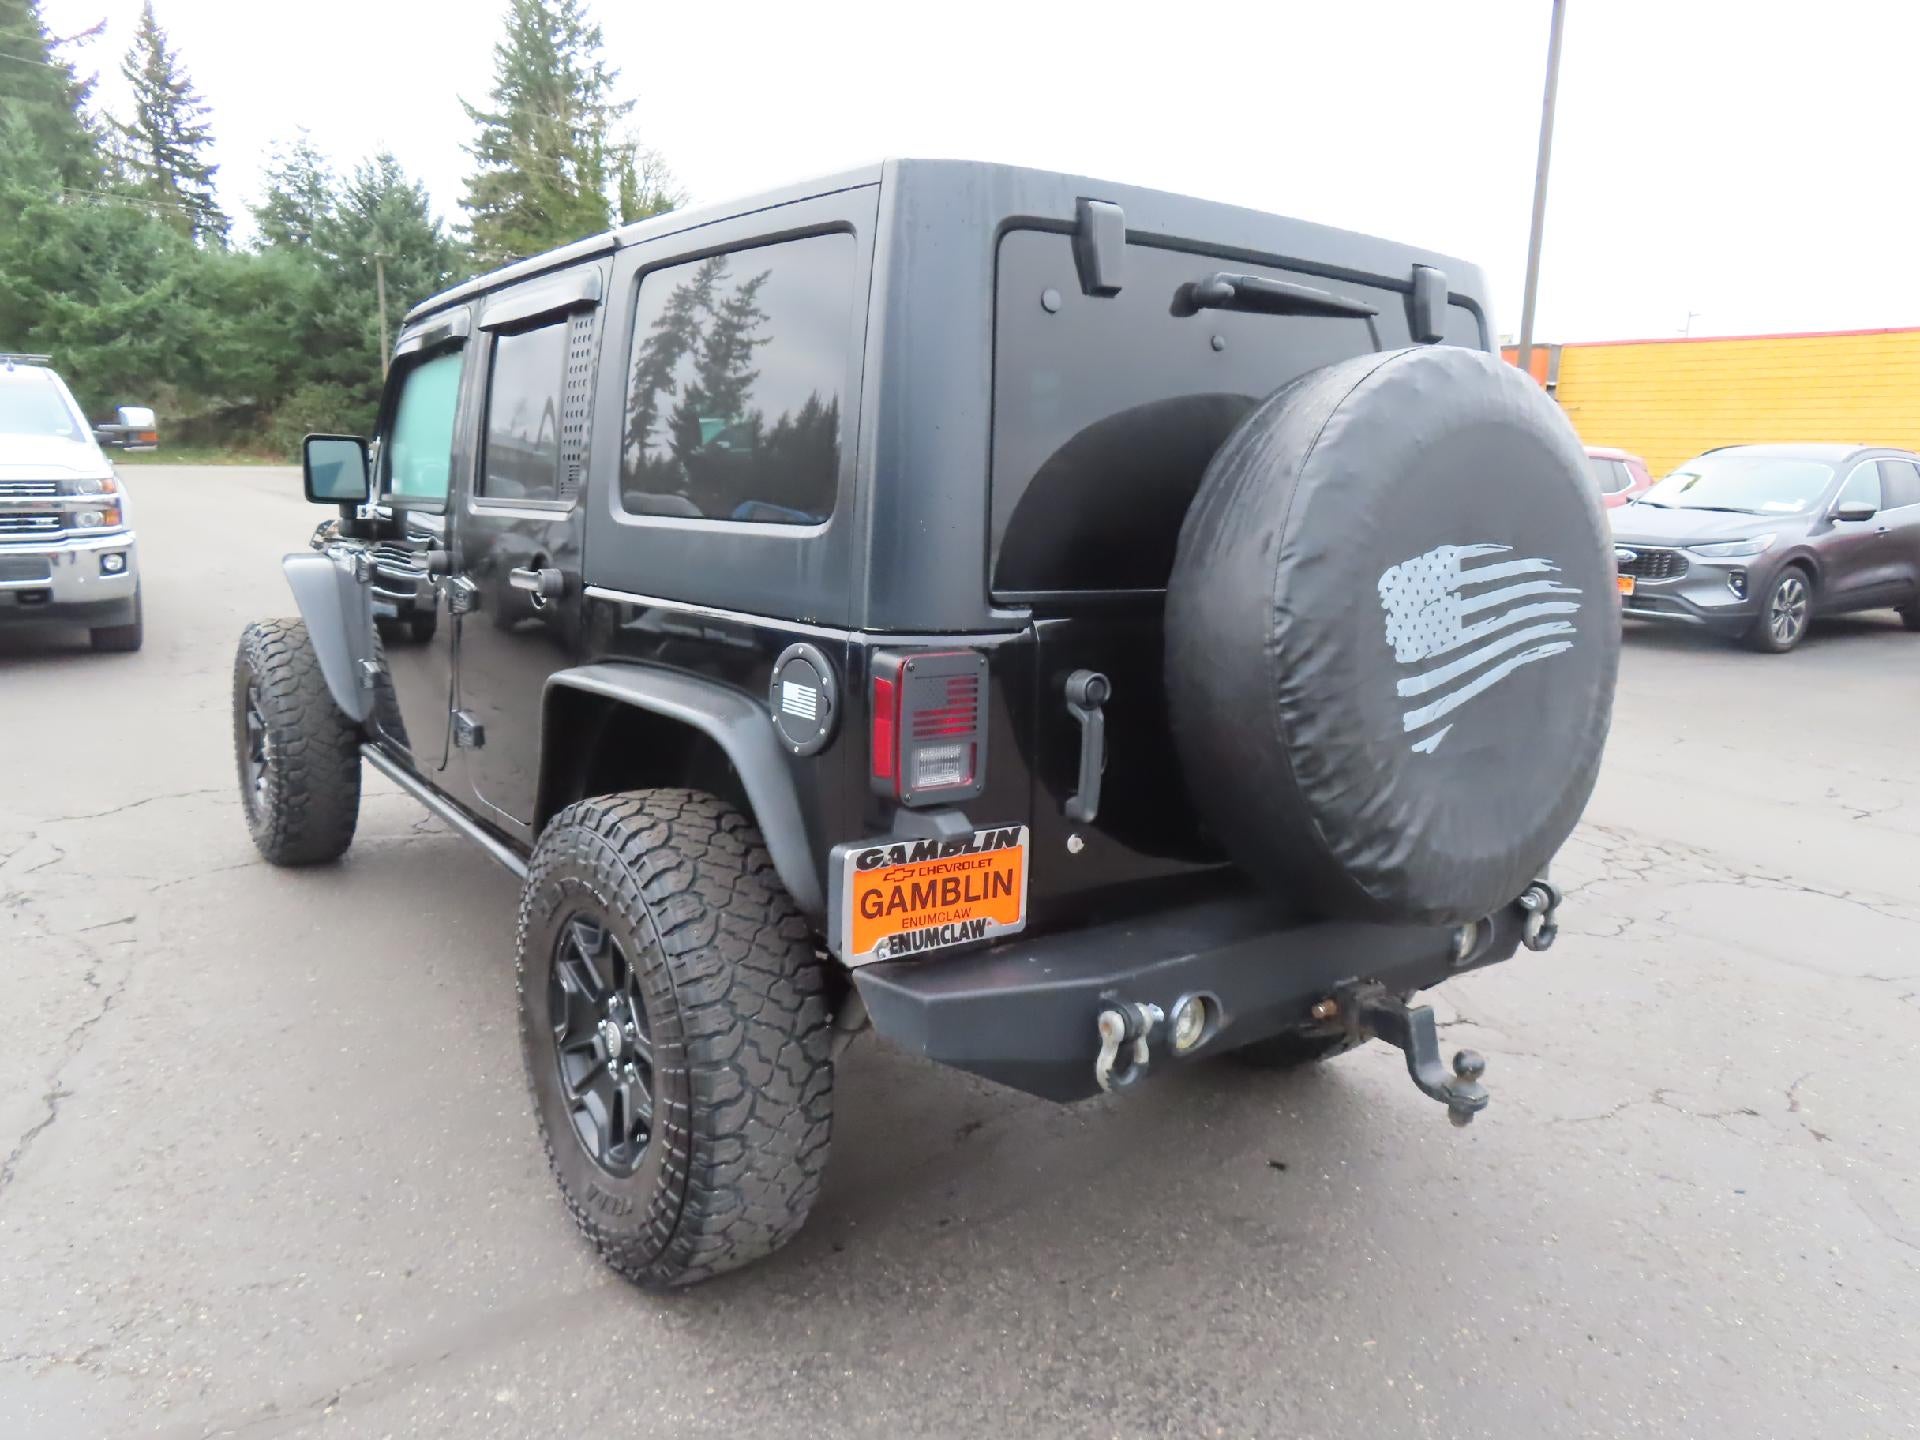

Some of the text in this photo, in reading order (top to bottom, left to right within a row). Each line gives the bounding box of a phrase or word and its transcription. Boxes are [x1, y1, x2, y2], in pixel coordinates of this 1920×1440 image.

[919, 858, 993, 877] CHEVROLET
[860, 868, 1013, 919] GAMBLIN
[901, 907, 972, 929] ENUMCLAW
[888, 918, 986, 955] ENUMCLAW
